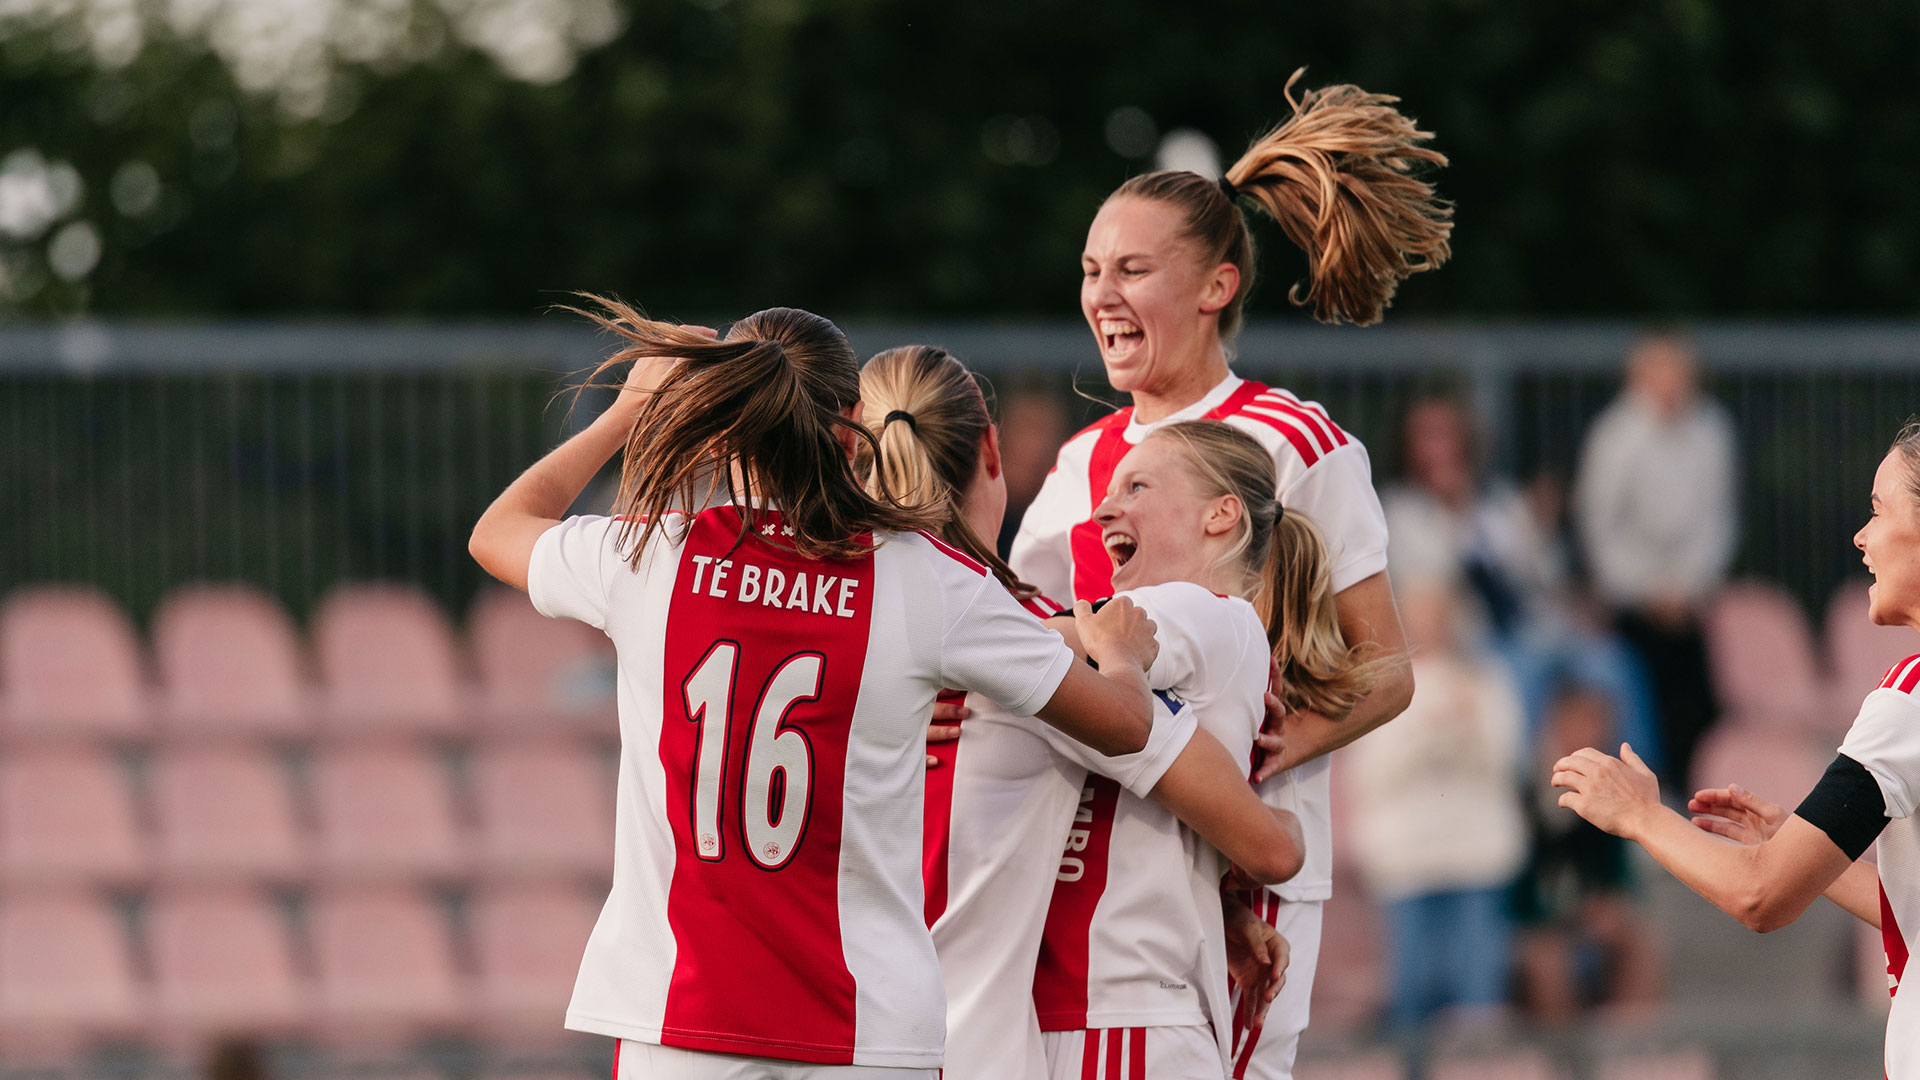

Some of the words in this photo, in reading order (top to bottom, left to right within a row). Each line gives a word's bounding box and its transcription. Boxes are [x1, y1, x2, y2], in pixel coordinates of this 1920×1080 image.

[692, 554, 733, 599] TE
[738, 564, 860, 618] BRAKE
[682, 638, 827, 872] 16
[1056, 770, 1096, 883] MBO
